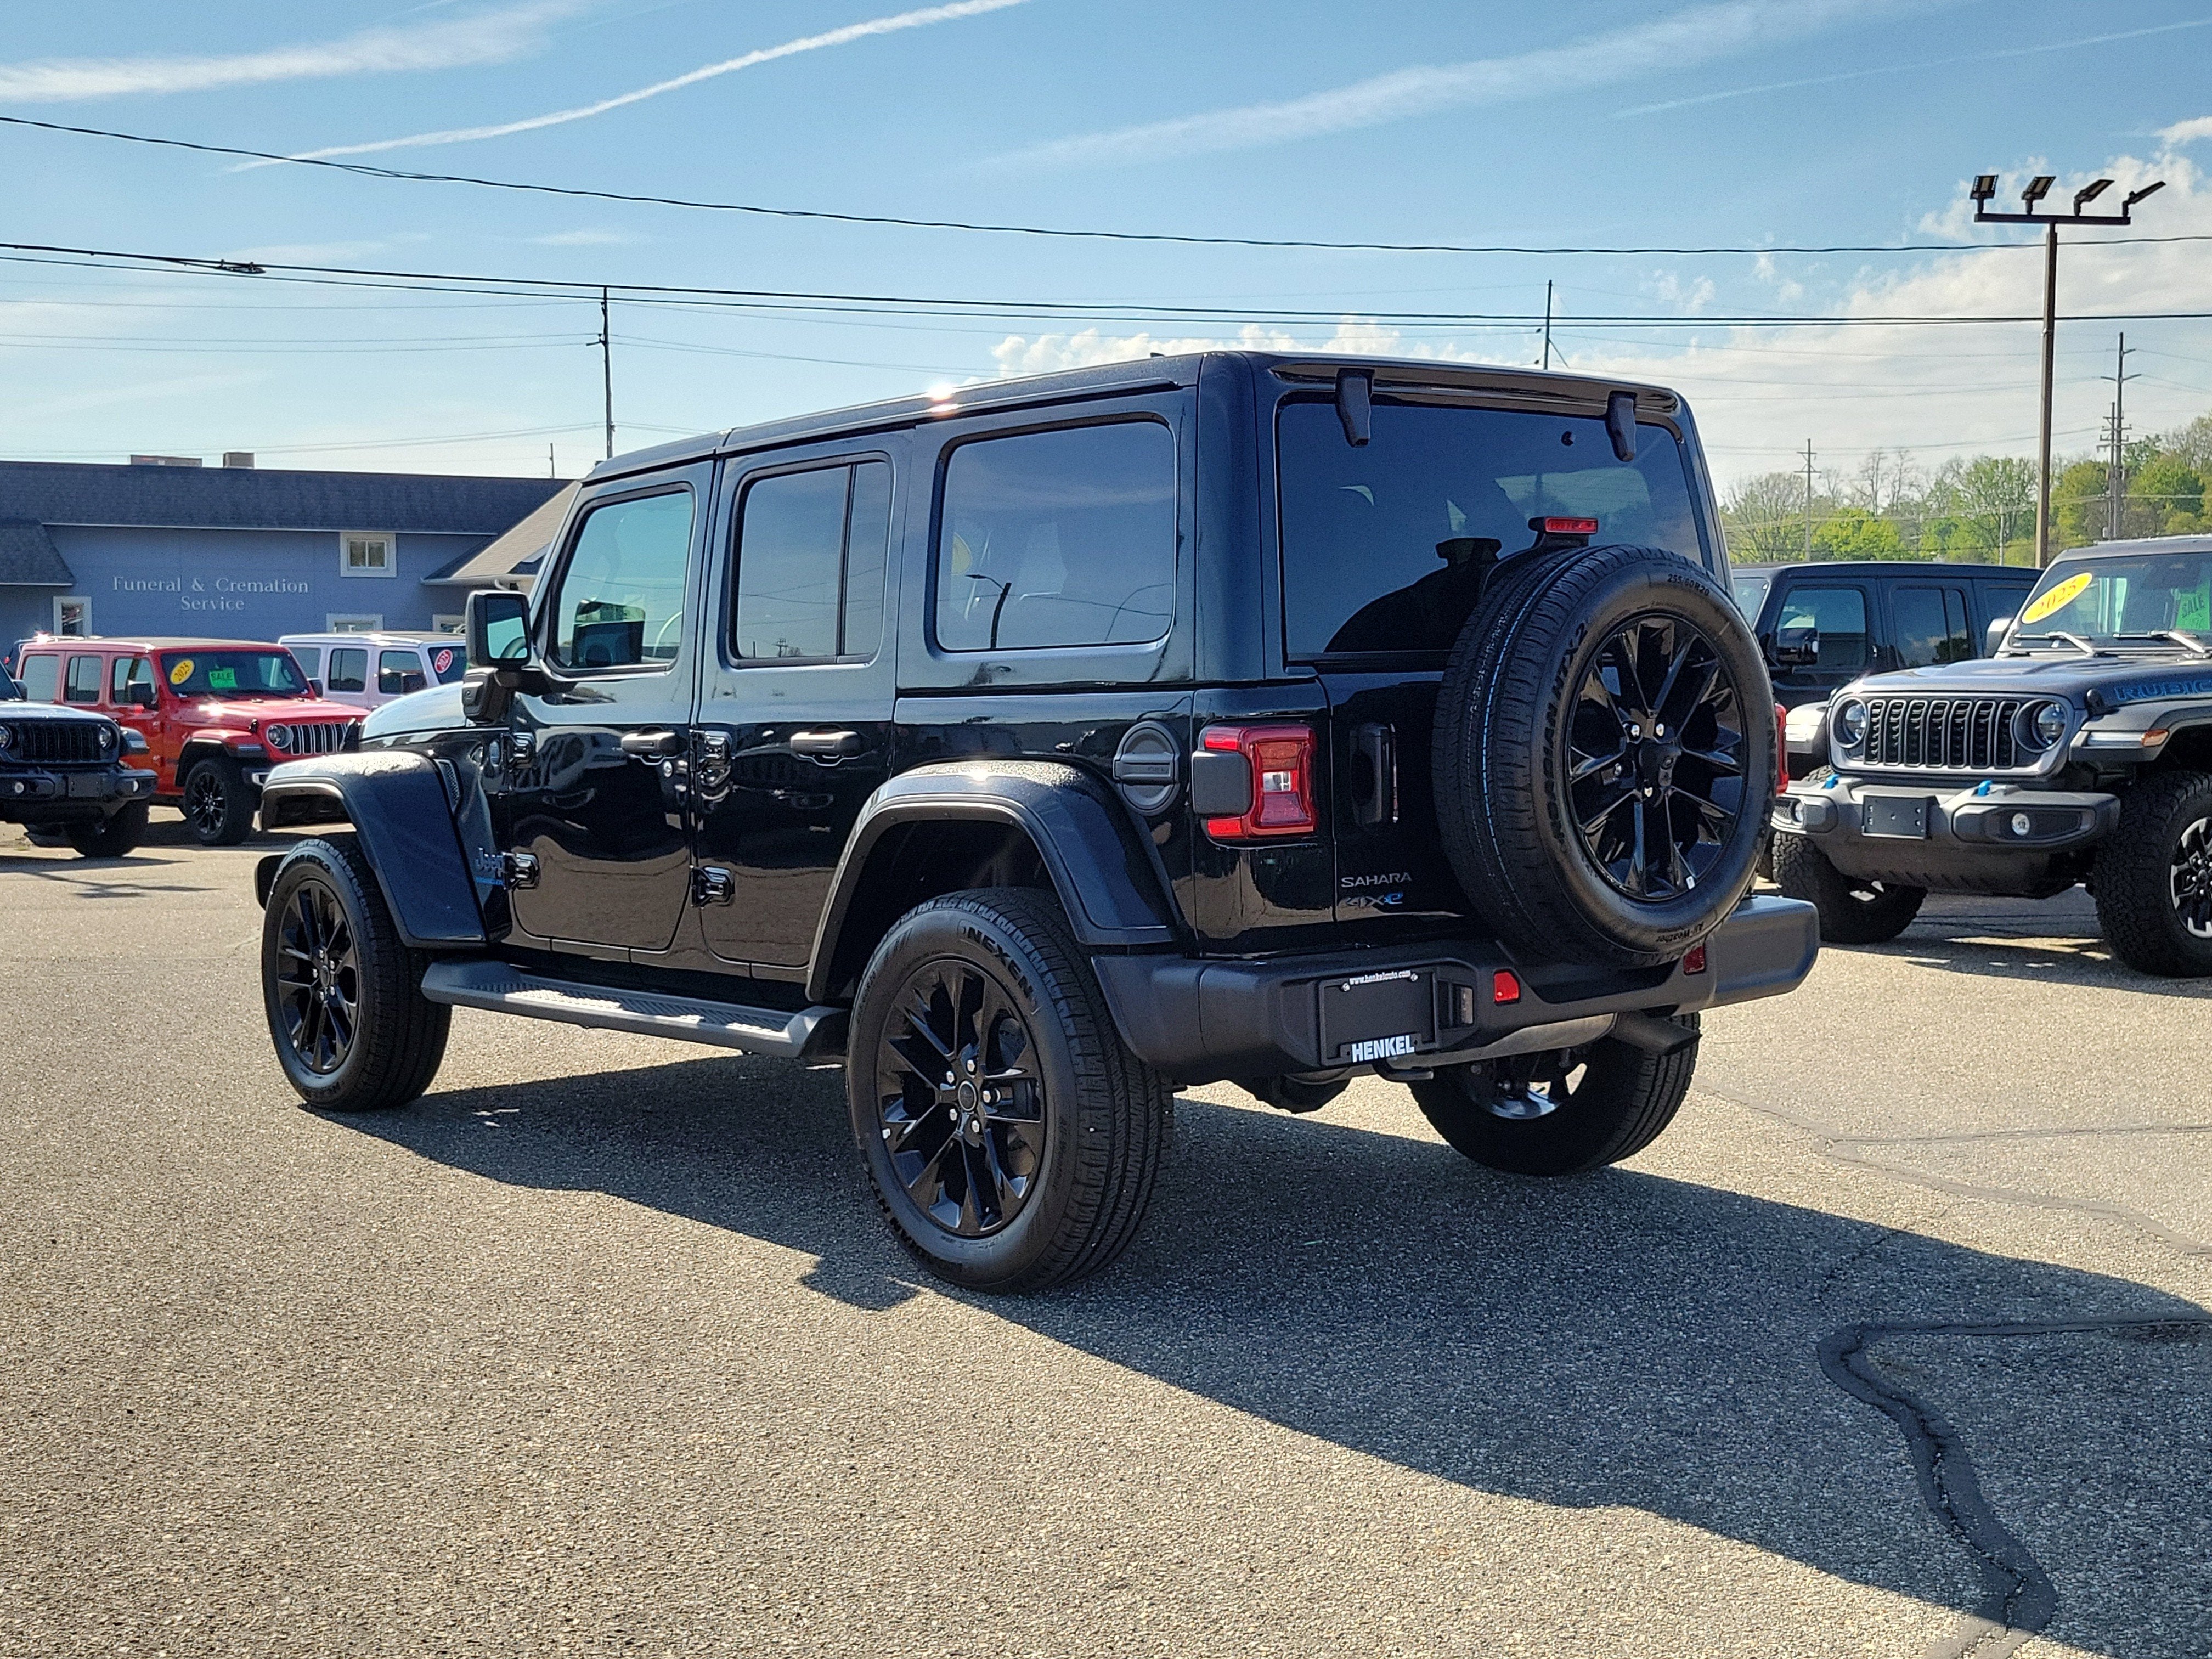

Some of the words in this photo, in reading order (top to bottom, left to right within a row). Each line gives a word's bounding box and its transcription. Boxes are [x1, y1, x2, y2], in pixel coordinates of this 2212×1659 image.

[113, 576, 182, 591] Funeral
[192, 578, 205, 591] &
[216, 578, 308, 592] Cremation
[181, 596, 245, 611] Service
[1341, 872, 1412, 888] SAHARA
[967, 927, 1034, 998] NEXEN
[1351, 1035, 1415, 1063] HENKEL
